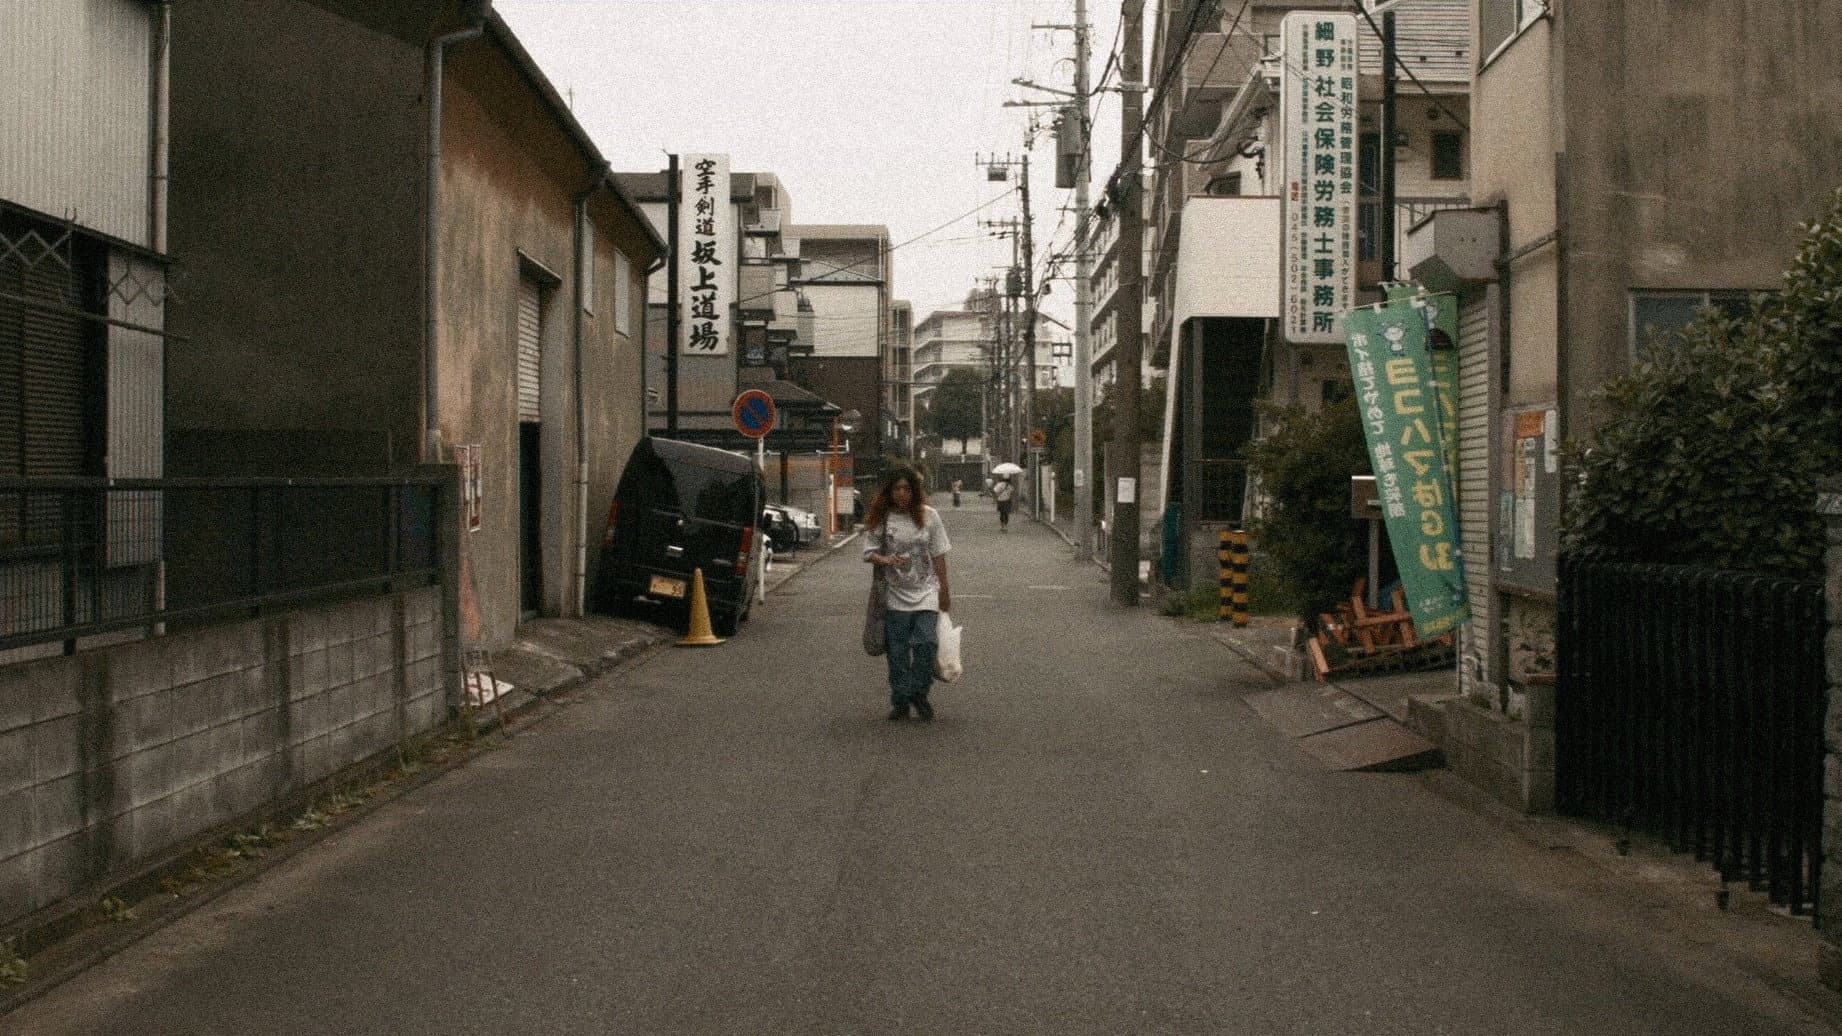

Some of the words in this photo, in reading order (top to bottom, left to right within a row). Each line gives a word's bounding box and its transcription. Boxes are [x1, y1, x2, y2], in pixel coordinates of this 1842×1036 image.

[1314, 21, 1335, 333] 細野社会保険労務士事務所
